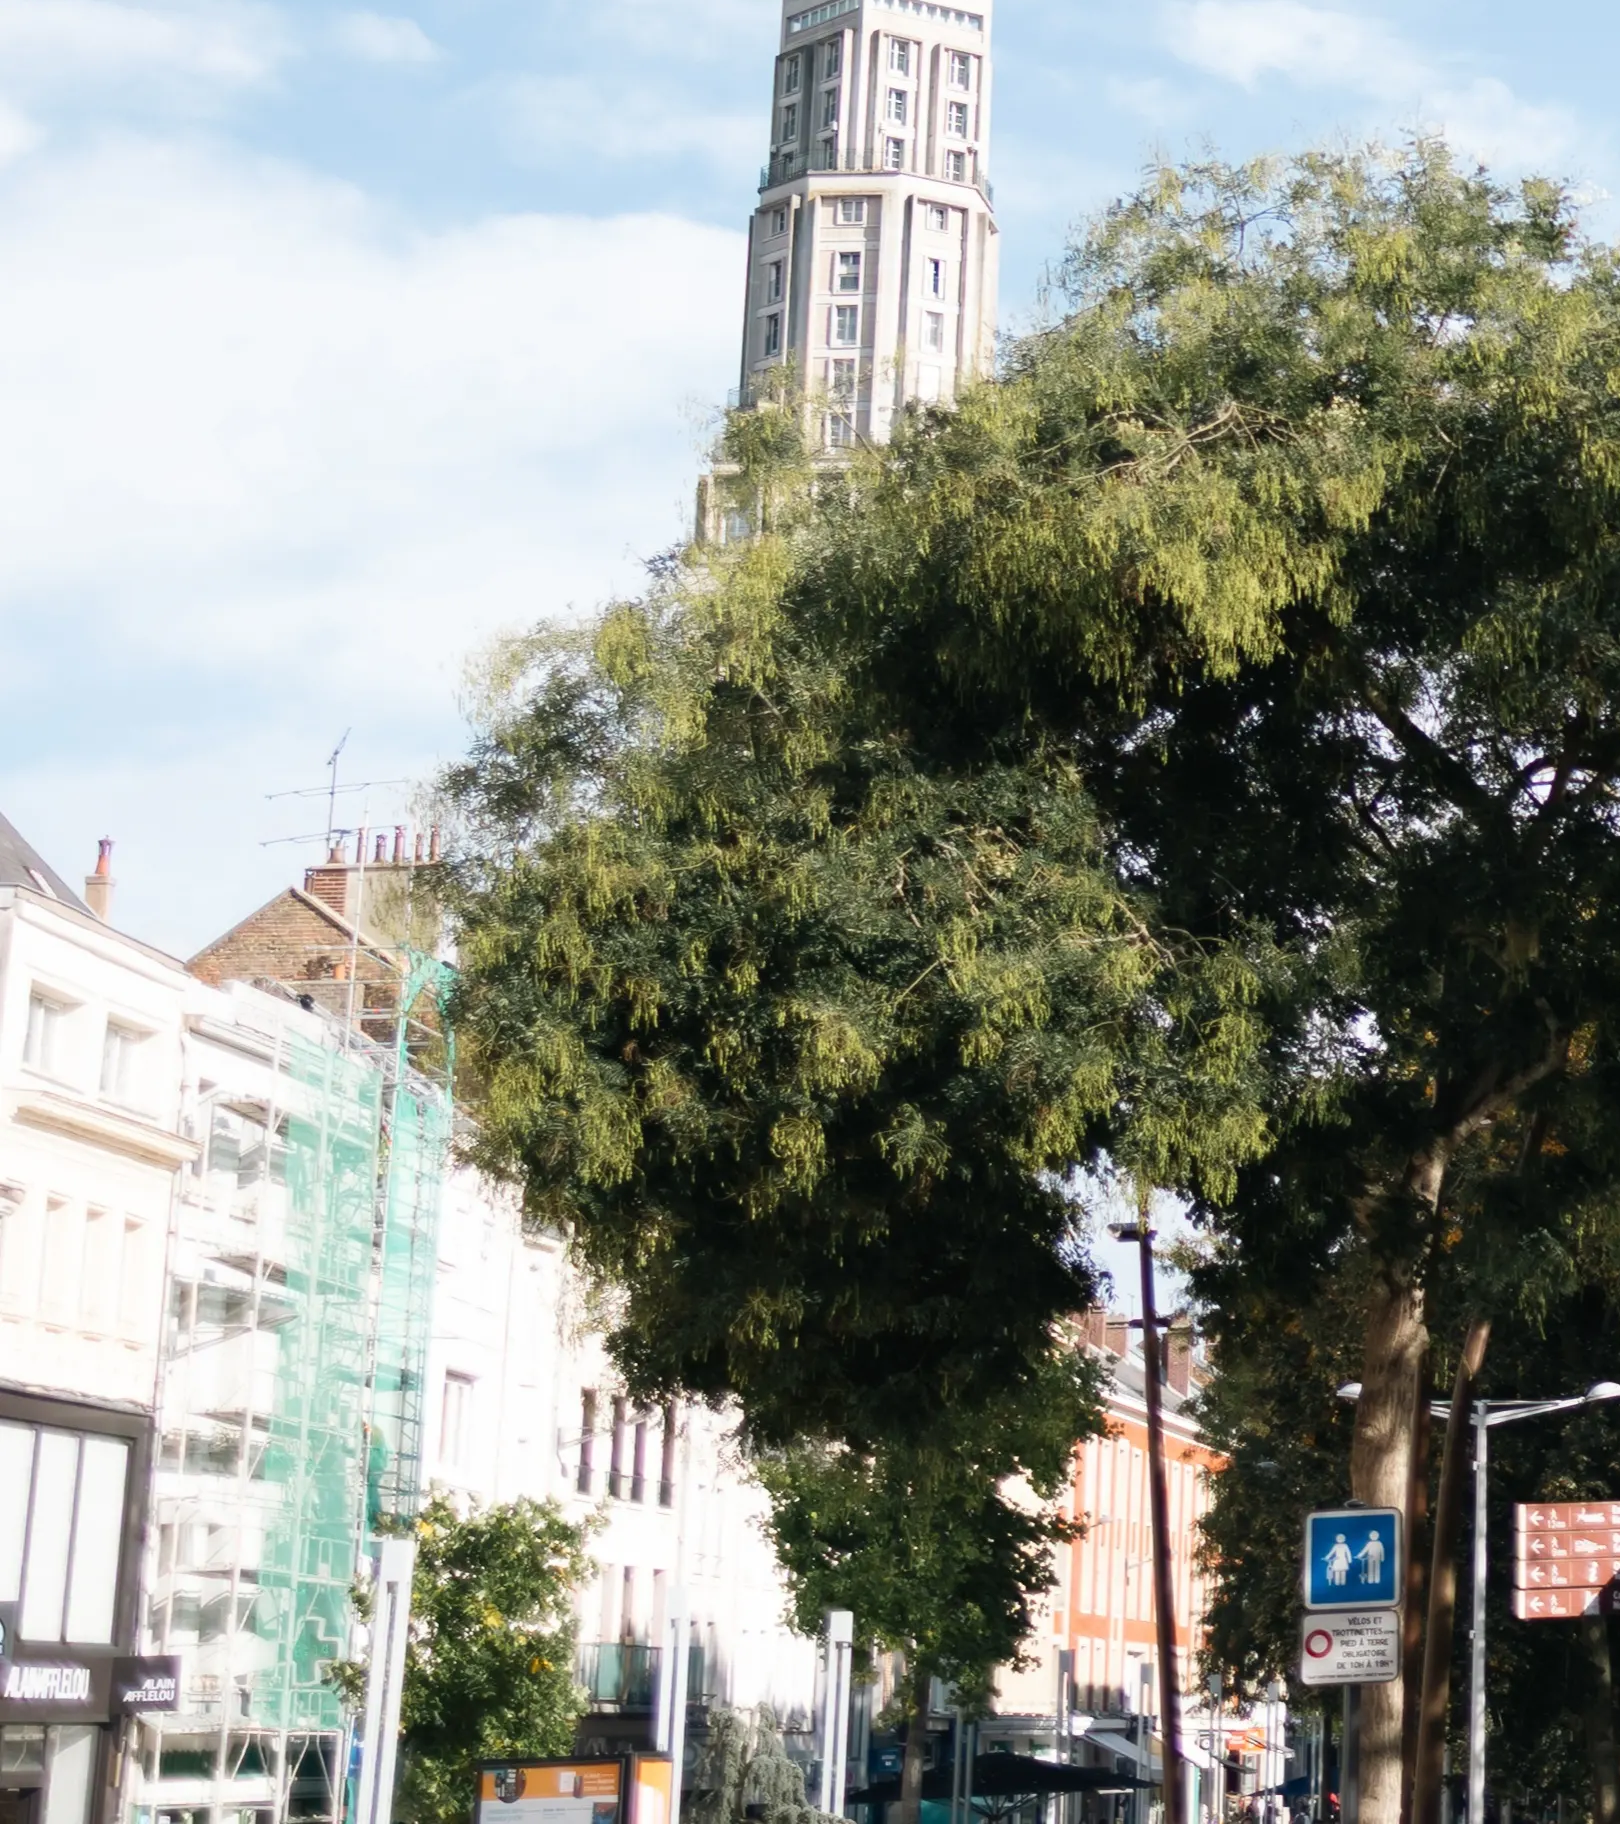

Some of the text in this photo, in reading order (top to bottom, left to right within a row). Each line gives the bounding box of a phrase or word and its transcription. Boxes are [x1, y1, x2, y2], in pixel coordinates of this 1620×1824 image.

[1347, 1616, 1383, 1626] VÉLOS ET
[1332, 1628, 1383, 1637] TROTTINETTES
[1340, 1639, 1357, 1647] PIED
[1367, 1638, 1389, 1646] TERRE
[1342, 1649, 1387, 1658] OBLIGATOIRE
[1336, 1661, 1346, 1669] DE
[142, 1678, 176, 1690] ALAIN
[123, 1690, 174, 1702] AFFLELOU
